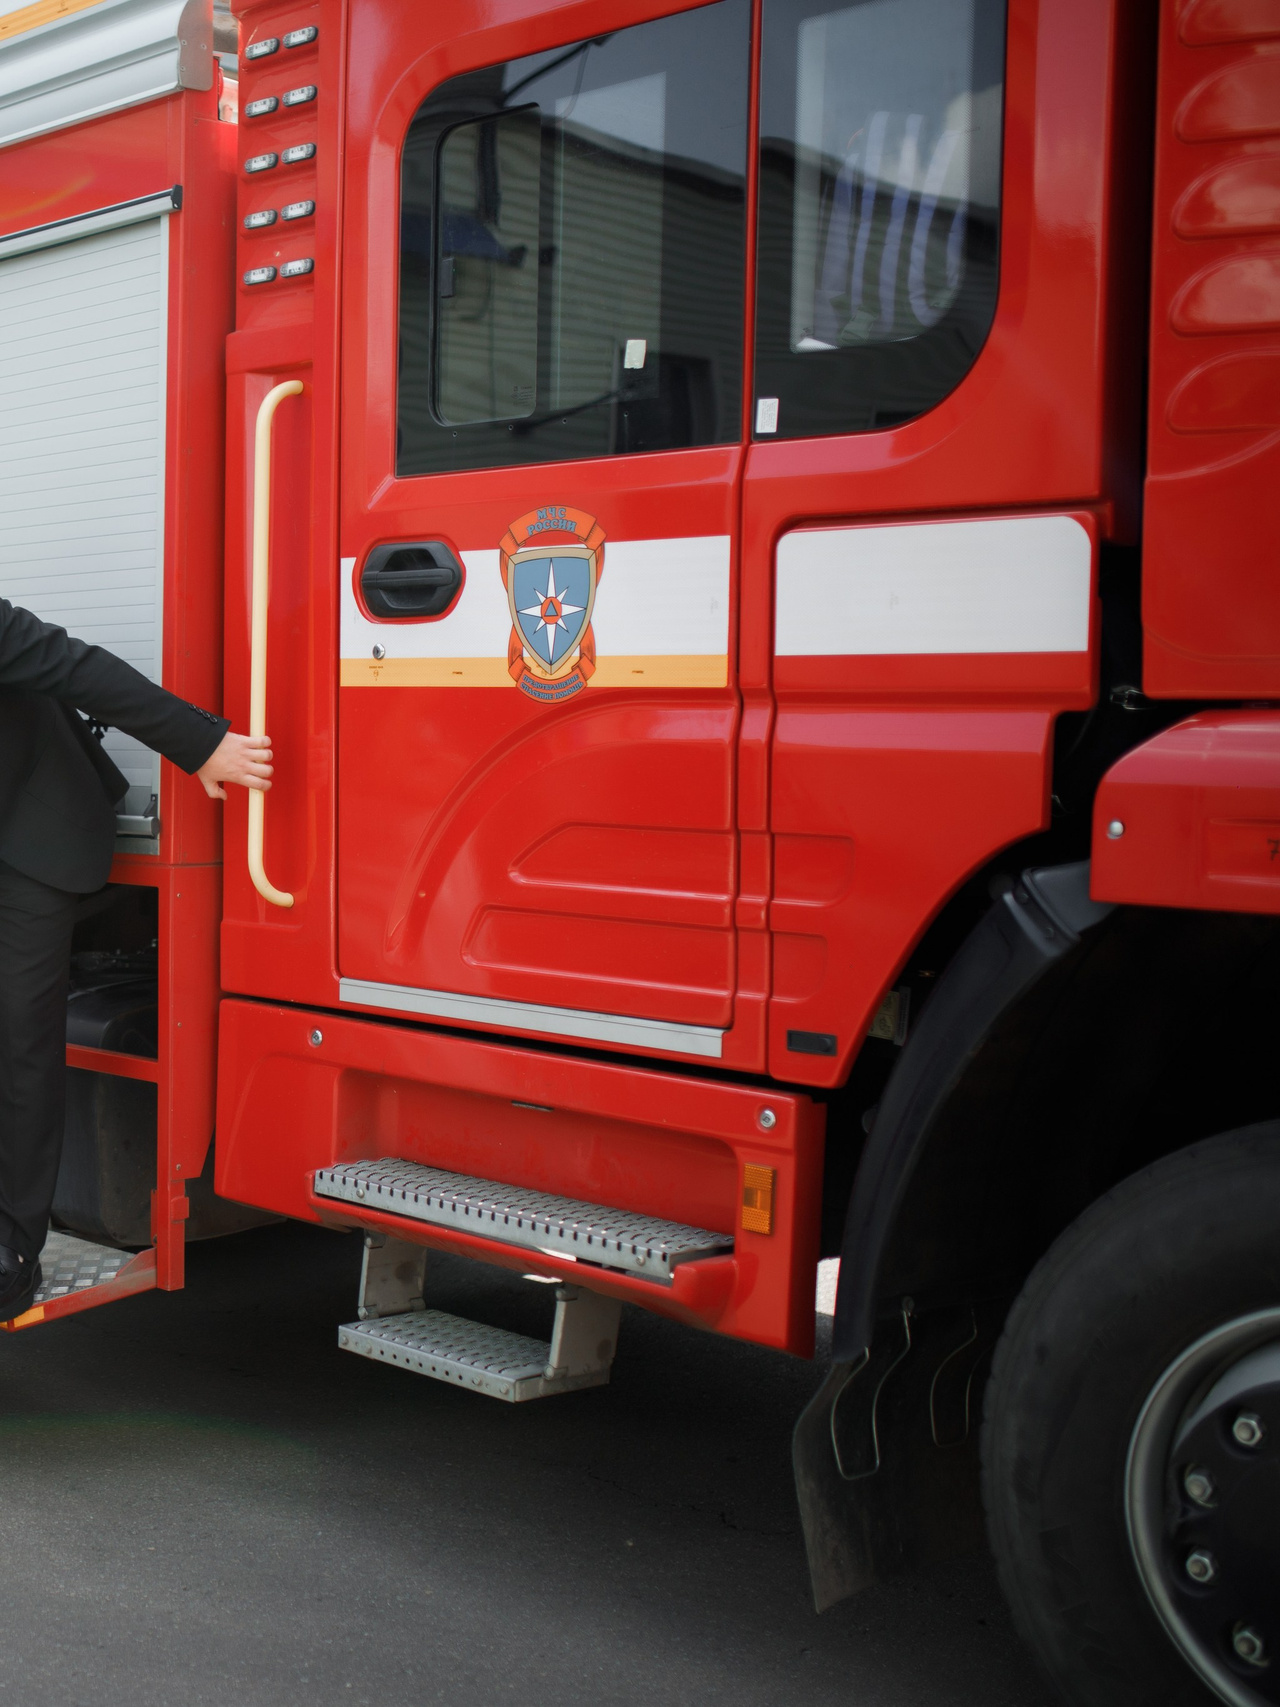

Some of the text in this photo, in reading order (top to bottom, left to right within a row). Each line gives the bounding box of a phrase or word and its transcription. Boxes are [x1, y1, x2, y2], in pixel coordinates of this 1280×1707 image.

[537, 506, 567, 520] МЧС
[526, 518, 577, 536] РОССИИ
[520, 680, 585, 700] СПАСЕНИЕ ПОМОЩЬ
